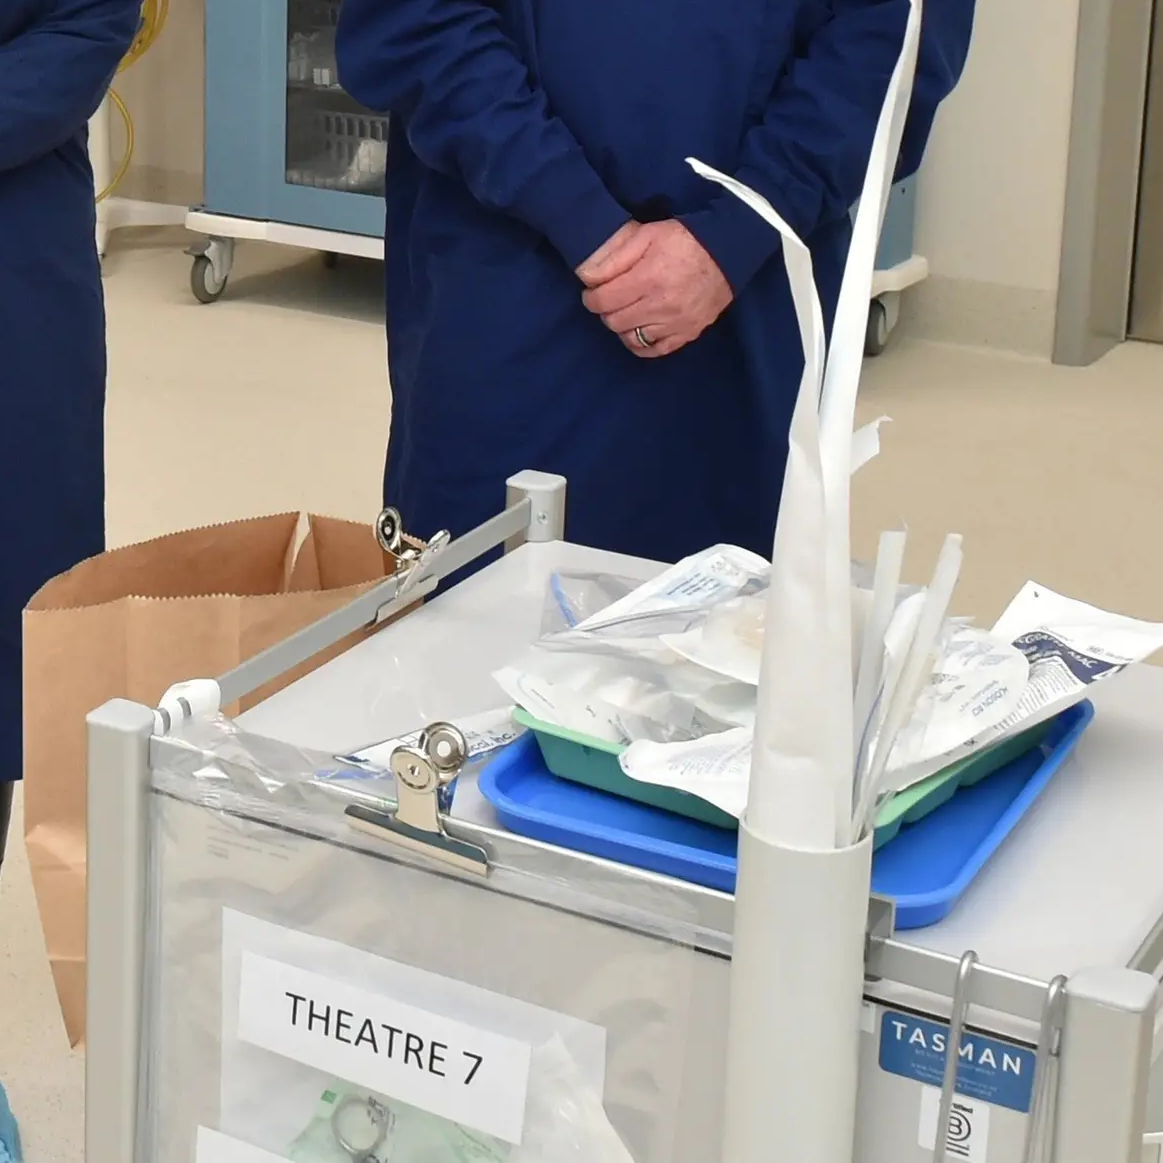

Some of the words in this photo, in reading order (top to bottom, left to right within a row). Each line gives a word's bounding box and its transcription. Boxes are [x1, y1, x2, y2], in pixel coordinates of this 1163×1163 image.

[285, 991, 448, 1078] THEATRE
[462, 1050, 484, 1086] 7
[892, 1020, 1021, 1076] TASMAN
